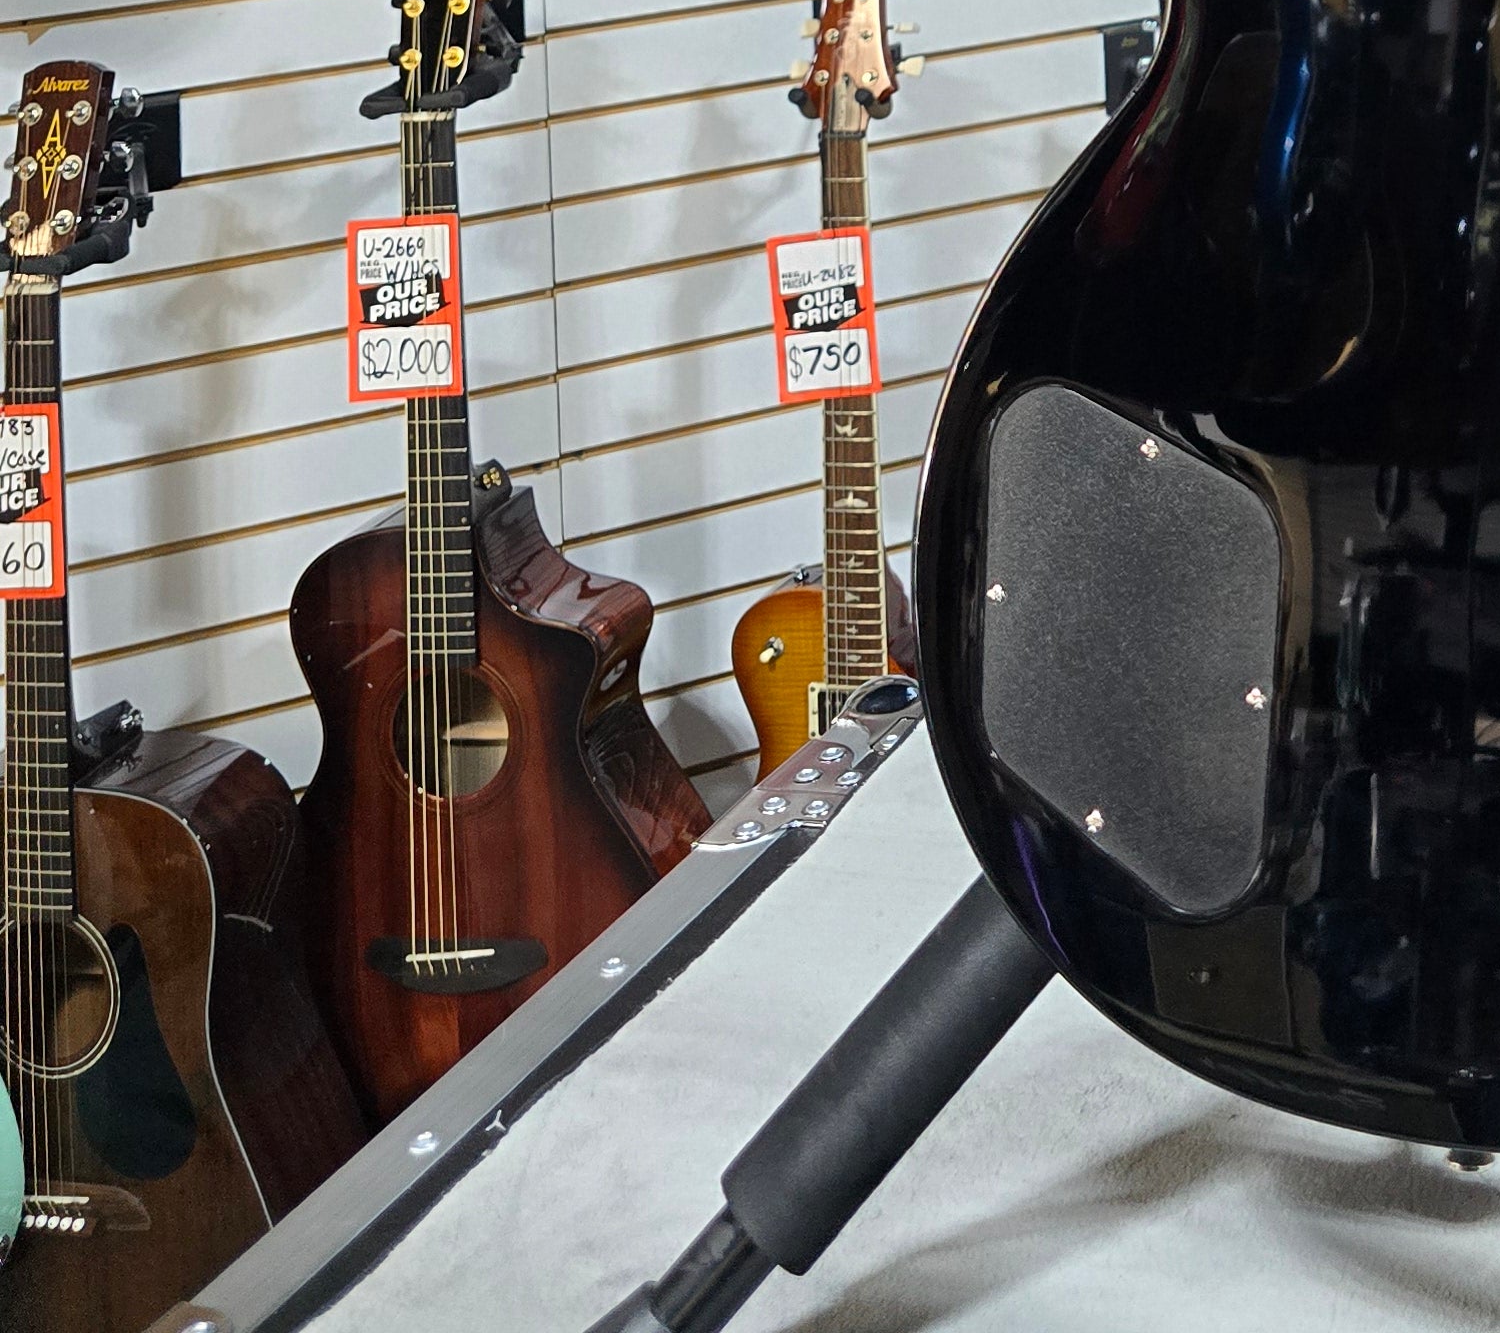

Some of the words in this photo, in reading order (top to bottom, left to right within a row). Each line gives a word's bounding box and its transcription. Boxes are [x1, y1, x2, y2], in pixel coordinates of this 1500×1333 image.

[33, 76, 90, 95] Alvarez
[360, 267, 382, 280] PRICE
[376, 279, 428, 304] OUR
[798, 287, 845, 311] OUR
[369, 292, 441, 323] PRICE
[792, 299, 857, 330] PRICE
[362, 337, 452, 381] $2,000
[789, 342, 861, 383] $750
